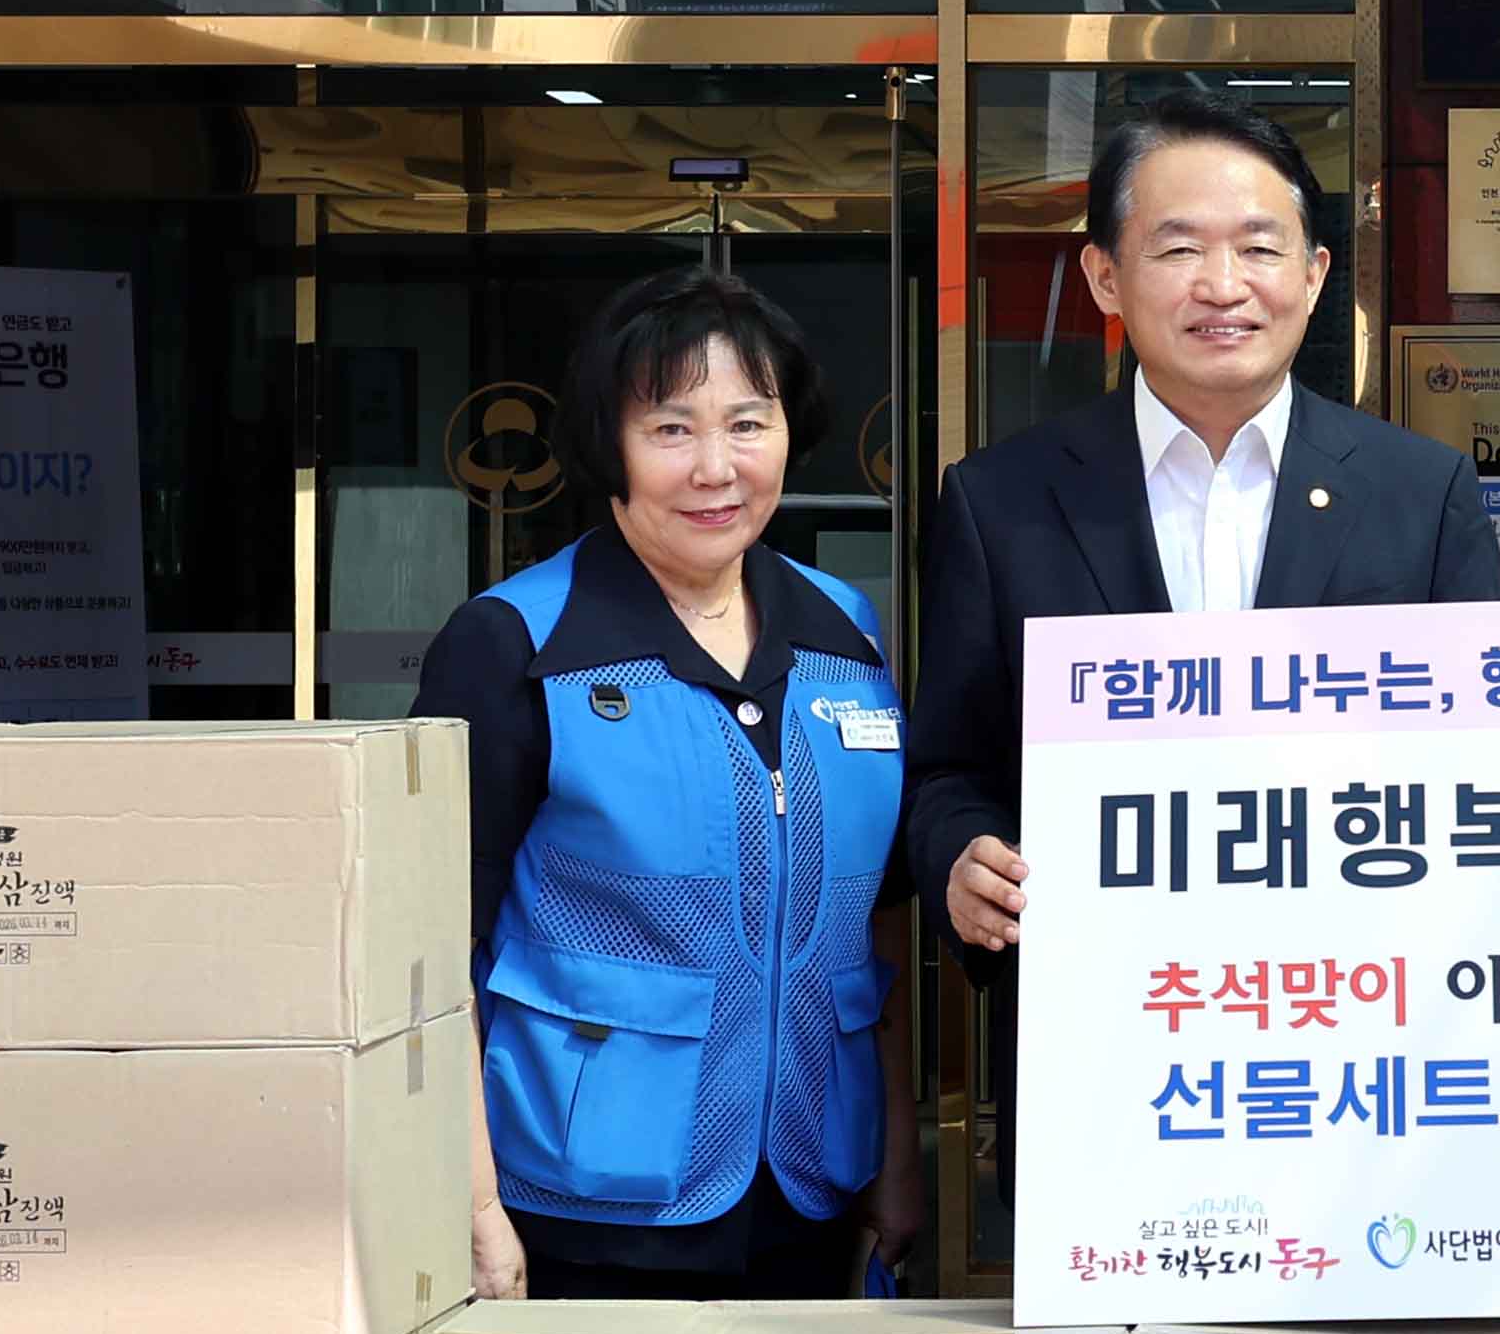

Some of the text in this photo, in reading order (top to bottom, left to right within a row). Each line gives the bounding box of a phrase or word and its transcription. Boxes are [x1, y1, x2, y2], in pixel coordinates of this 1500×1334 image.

[2, 313, 42, 331] 연금도
[46, 315, 72, 332] 받고
[1461, 369, 1493, 378] World
[1472, 423, 1500, 435] This
[1069, 654, 1223, 721] 『함께
[1251, 650, 1453, 716] 나누는,
[1142, 956, 1411, 1033] 추석맞이
[1148, 1056, 1500, 1142] 선물세트
[1139, 1217, 1269, 1241] 살고 싶은 도시!
[1068, 1237, 1341, 1282] 활기찬 행복도시 동구
